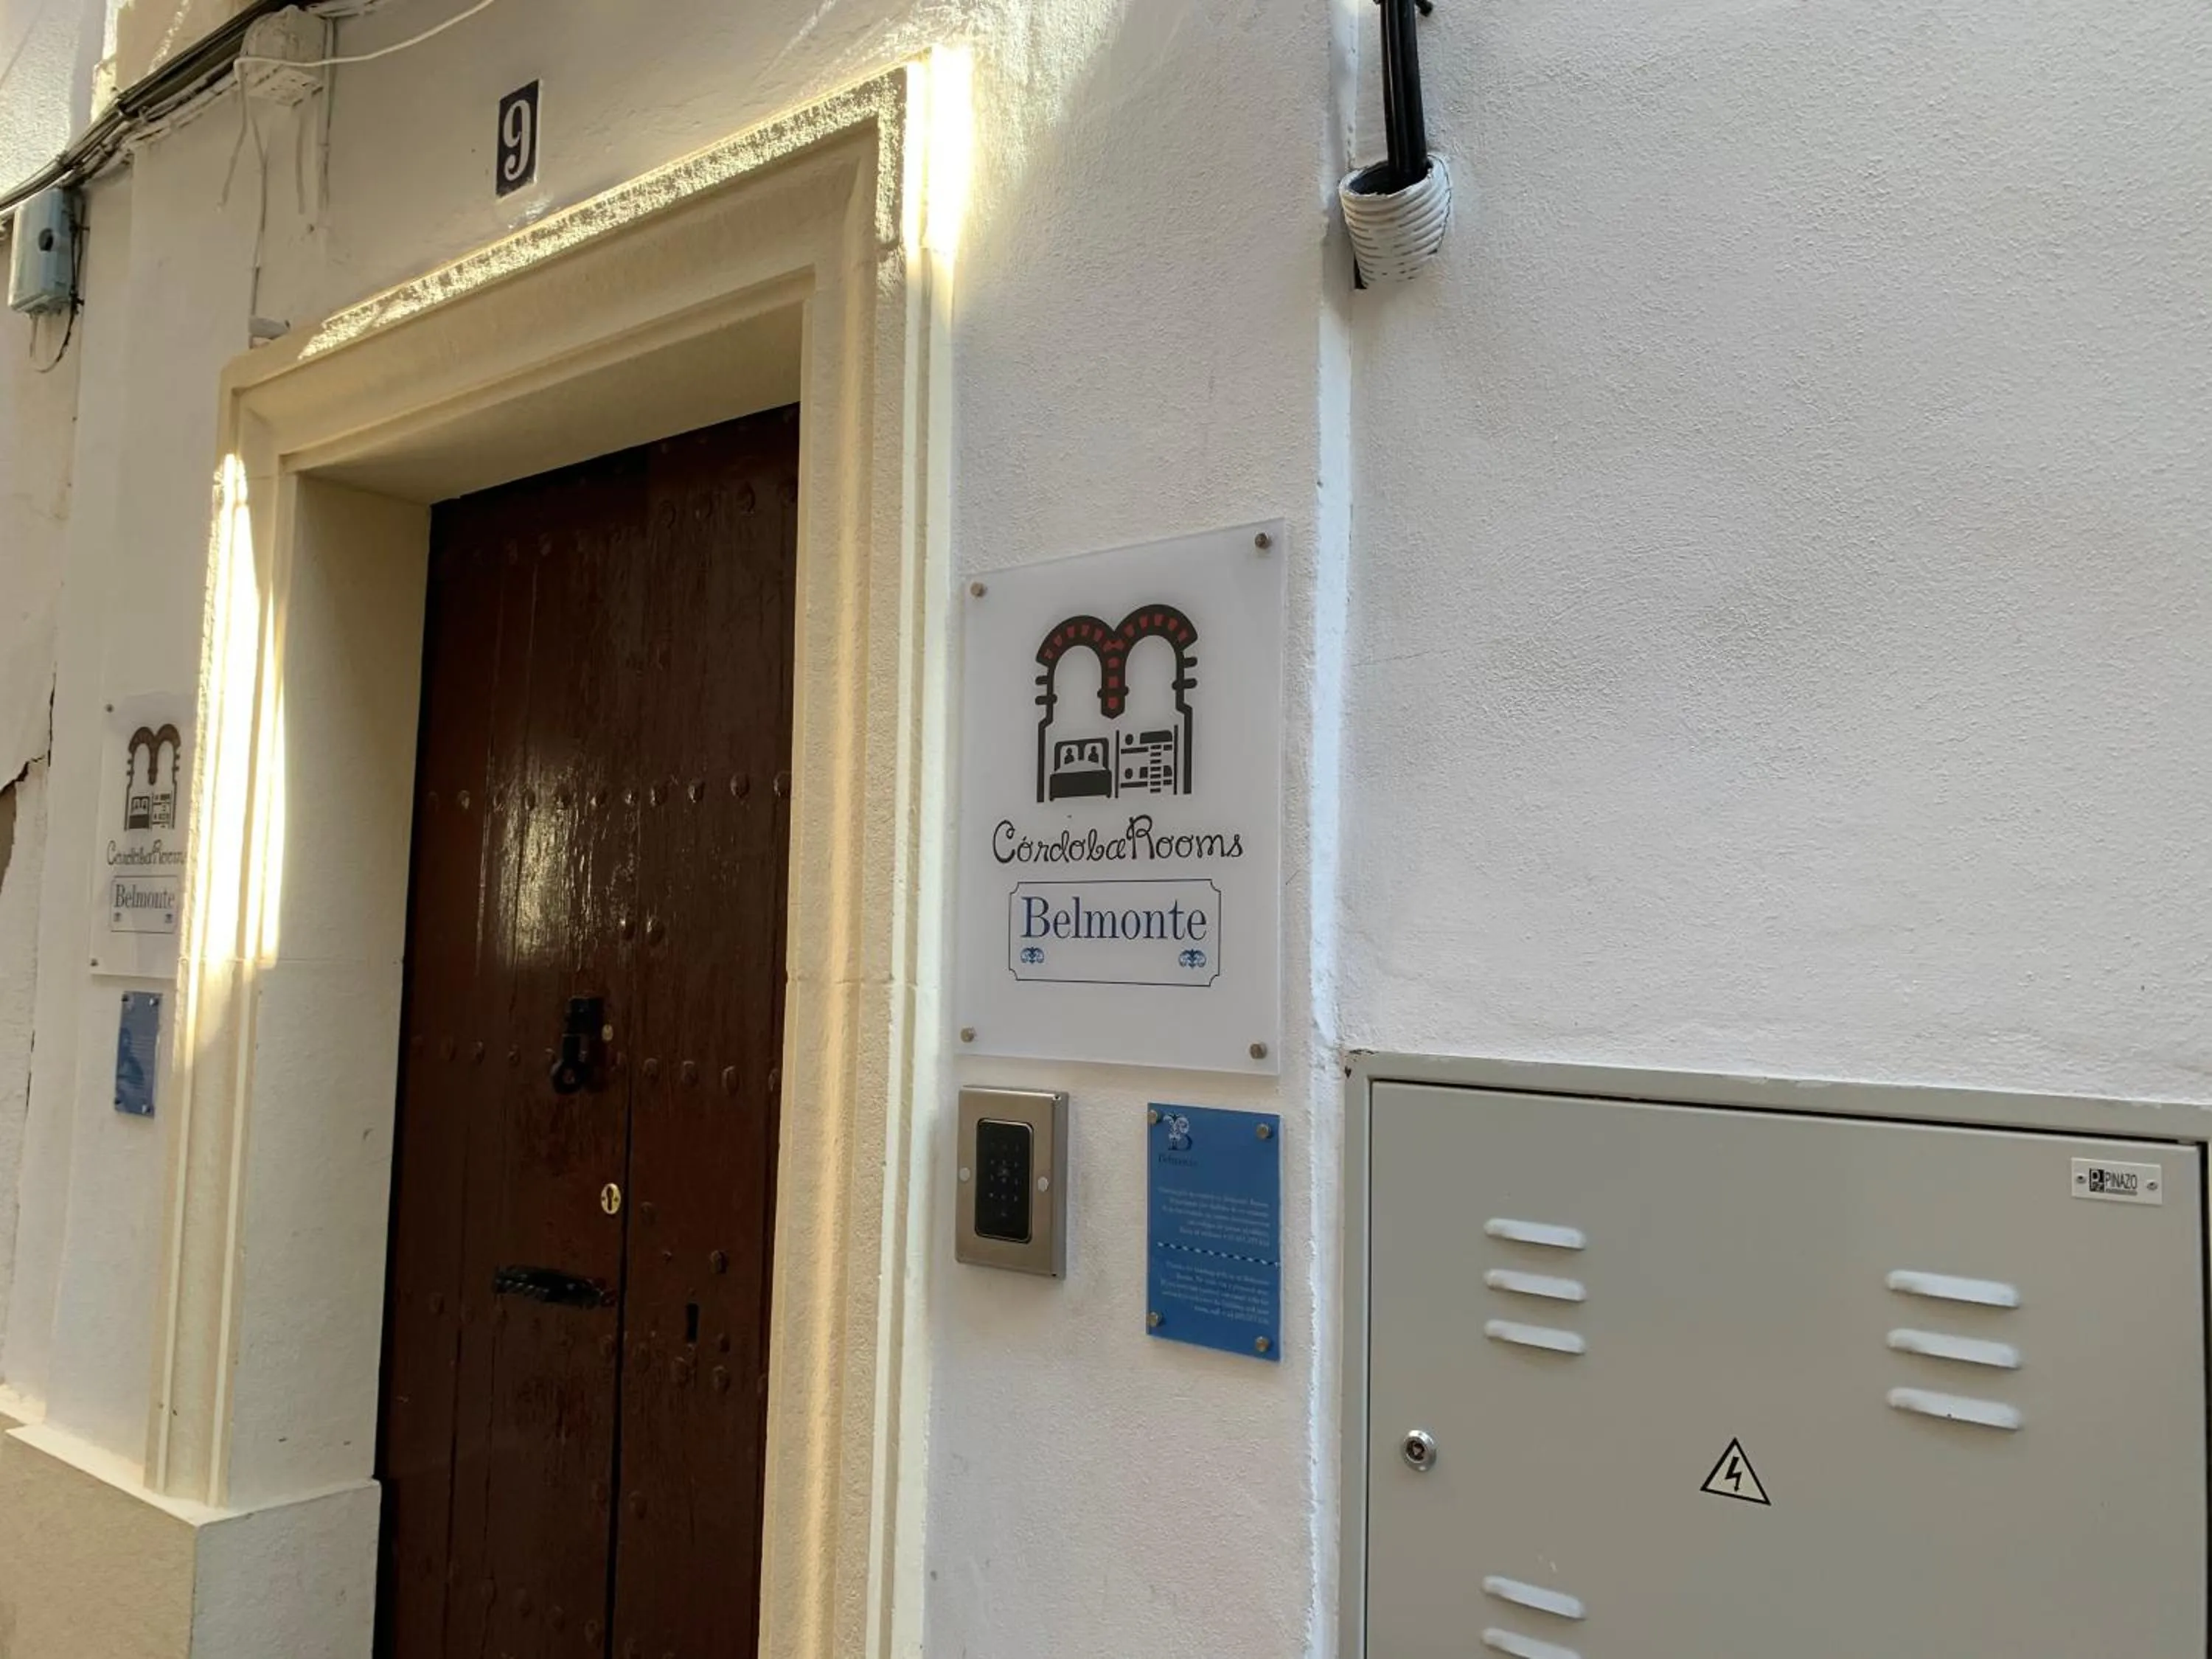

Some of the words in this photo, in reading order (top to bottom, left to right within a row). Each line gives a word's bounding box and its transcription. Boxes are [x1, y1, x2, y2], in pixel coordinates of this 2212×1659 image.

[503, 100, 531, 181] 9
[1020, 896, 1207, 940] Belmonte
[2105, 1172, 2138, 1189] PINAZO
